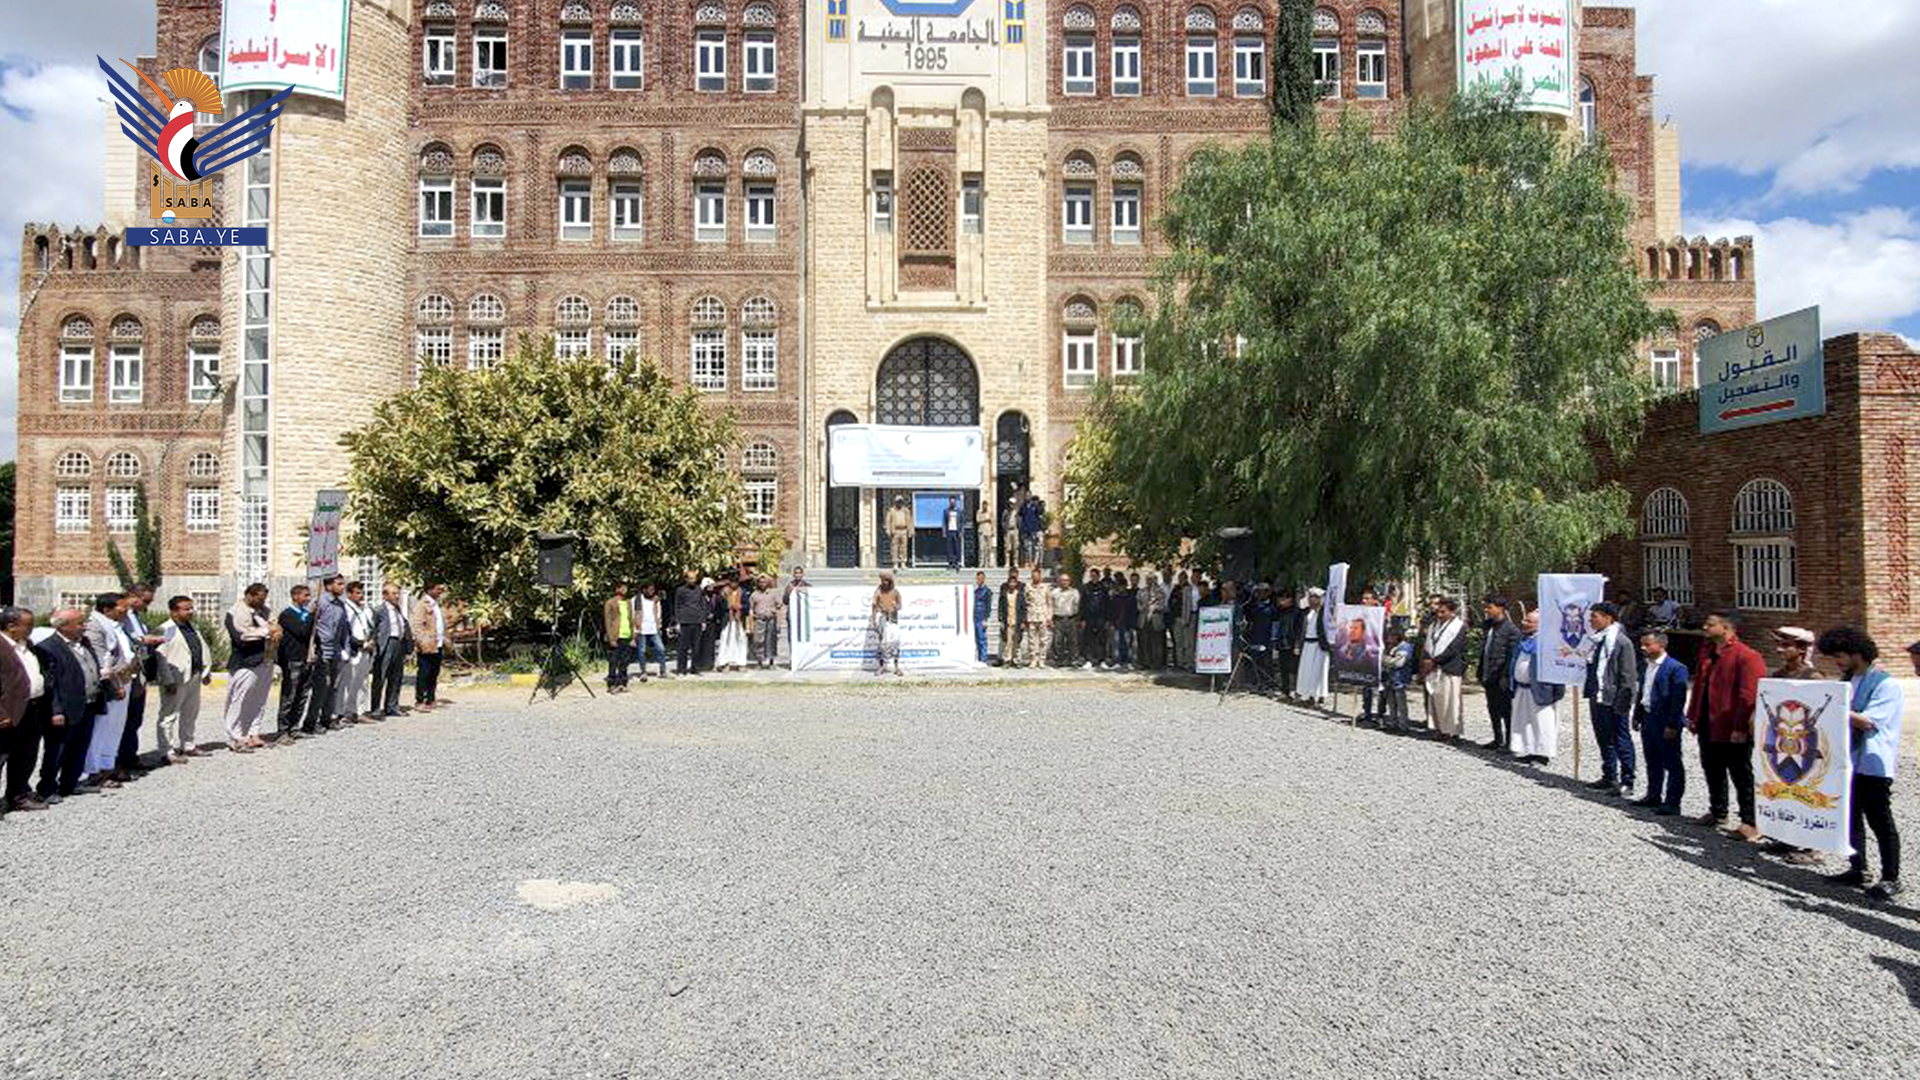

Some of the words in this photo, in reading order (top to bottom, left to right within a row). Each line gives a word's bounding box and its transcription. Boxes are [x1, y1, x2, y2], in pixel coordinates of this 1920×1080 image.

[858, 17, 924, 50] اليمنية
[927, 17, 998, 50] الجامعة
[227, 36, 336, 74] الإسرائيلية
[904, 46, 948, 70] 1995
[1718, 343, 1798, 382] القبول
[1718, 374, 1800, 405] والتسجيل
